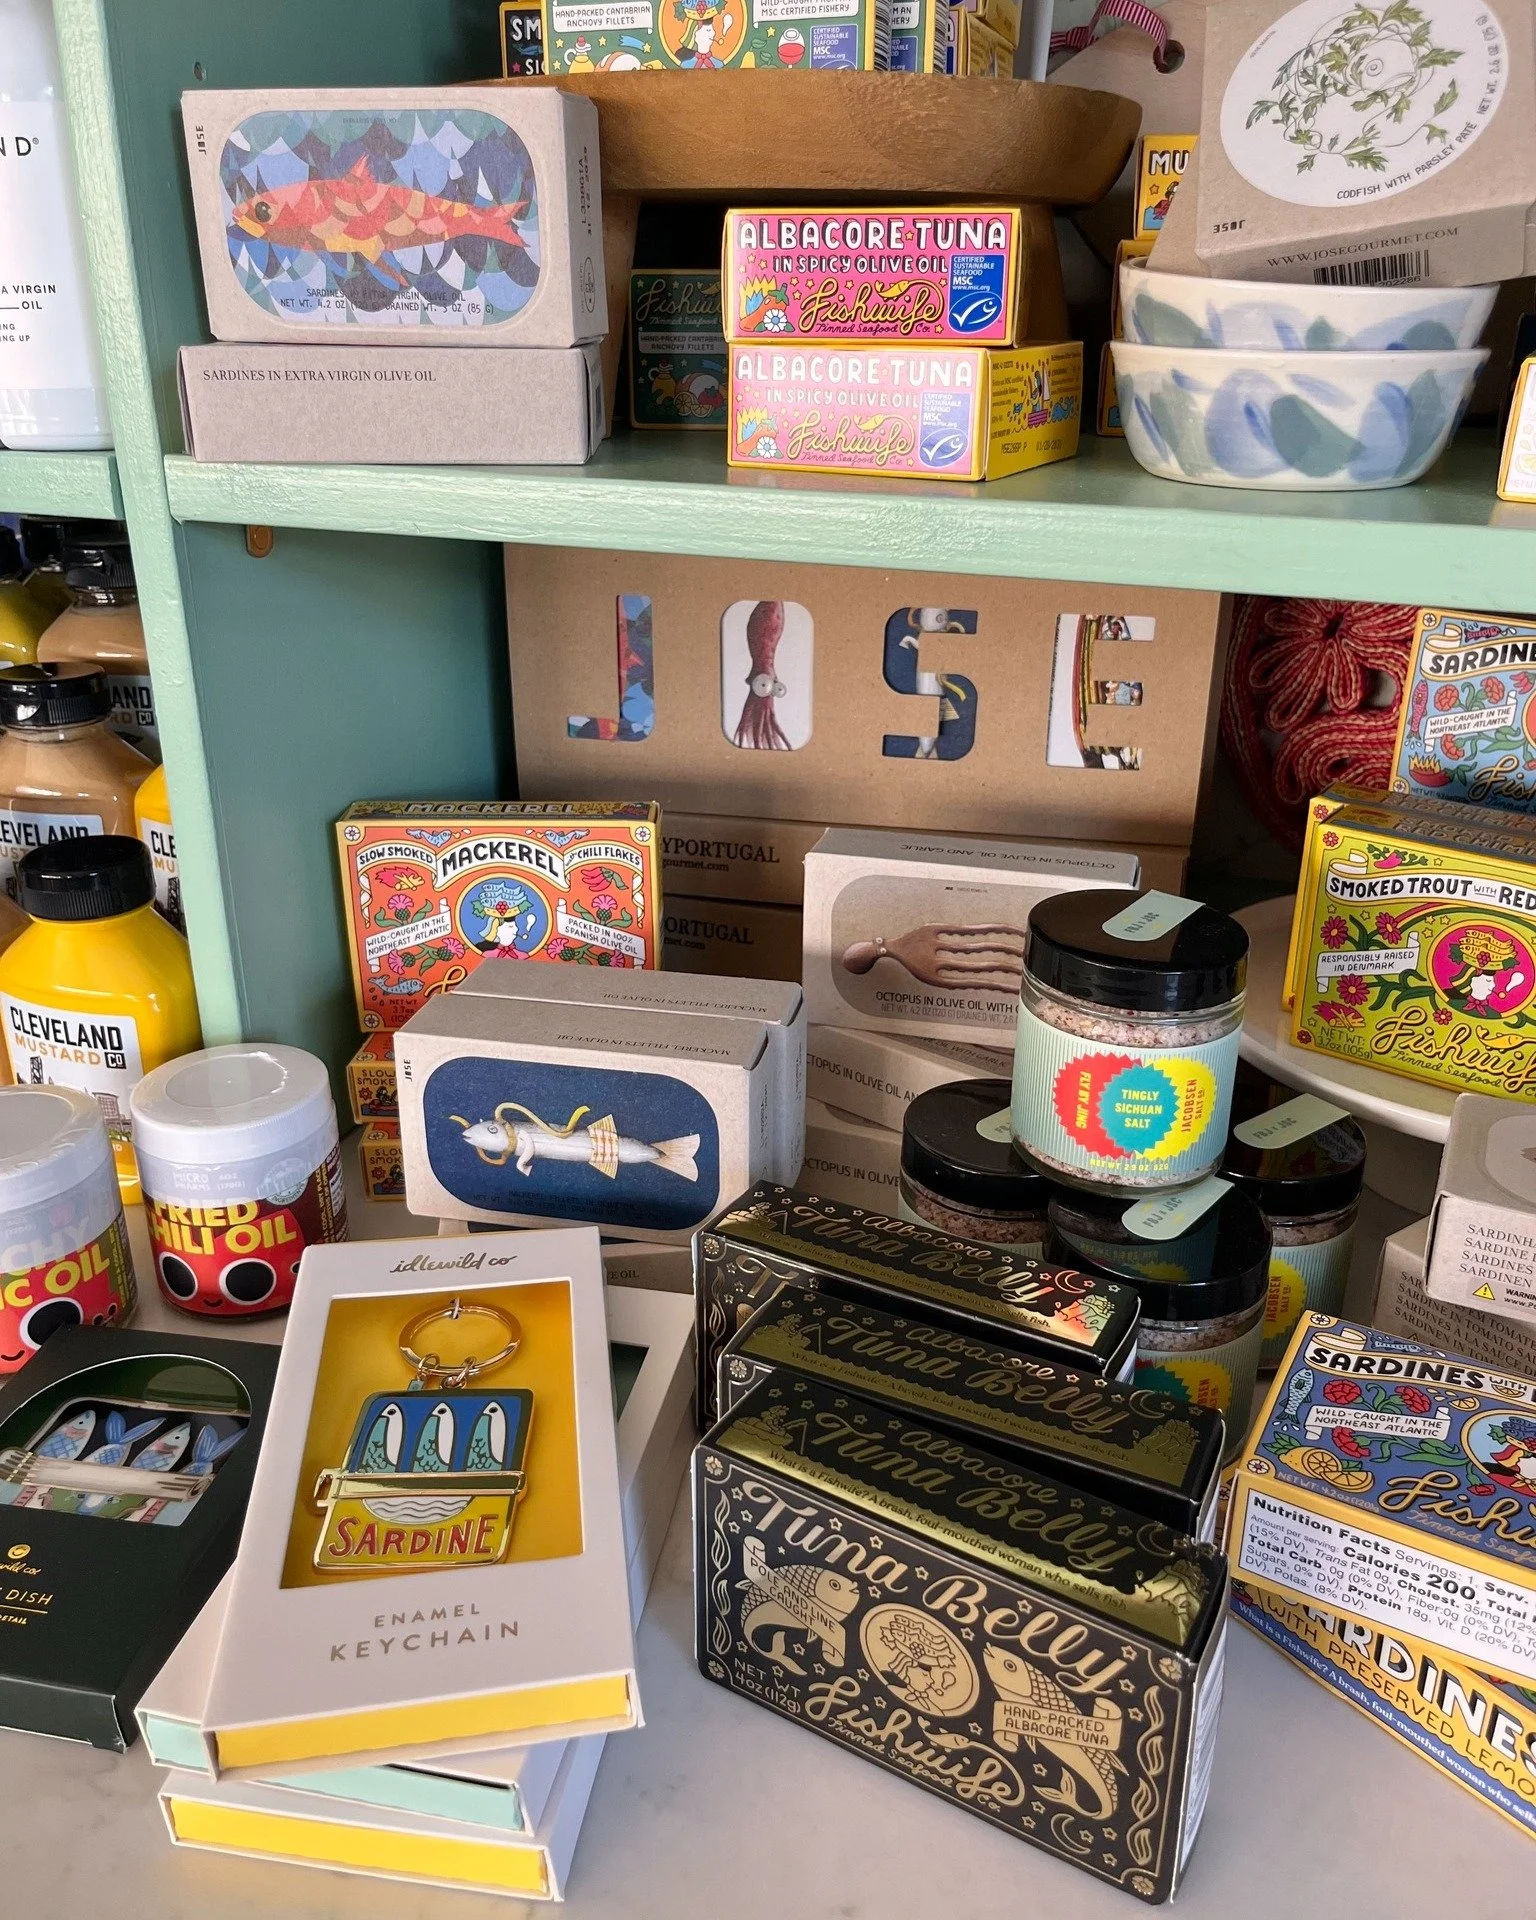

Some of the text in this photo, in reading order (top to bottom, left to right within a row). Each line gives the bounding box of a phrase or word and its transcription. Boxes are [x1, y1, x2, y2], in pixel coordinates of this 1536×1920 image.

[555, 5, 651, 19] HAND-PACKED CANTABRIAN
[566, 16, 635, 27] ANCHOVY FILLETS
[761, 4, 850, 17] MSC CERTIFIED FISHERY
[813, 46, 831, 55] MSC
[1336, 146, 1456, 200] CODFISH WITH PARSLEY
[739, 217, 1006, 250] ALBACORE TUNA
[773, 253, 949, 274] IN SPICY OLIVE OIL
[953, 262, 995, 270] SUSTAINABLE
[13, 285, 57, 294] VIRGIN
[953, 276, 974, 286] MSC
[22, 300, 43, 310] OIL
[799, 277, 945, 334] Fishwife
[856, 323, 898, 337] Seafood
[203, 370, 436, 382] SARDINES IN EXTRA VIRGIN OLIVE OIL
[736, 351, 973, 387] ALBACORE TUNA
[767, 388, 919, 409] IN SPICY OLIVE OIL
[787, 410, 915, 467] Fishwife
[1429, 707, 1512, 726] WILD-CAUGHT IN THE
[1473, 717, 1509, 728] ATLANTIC
[359, 841, 641, 878] SLOW SMOKED MACKEREL CHILI FLAKES
[1056, 858, 1115, 870] OCTOPUS
[1329, 877, 1404, 898] SMOKED
[1407, 877, 1473, 897] TROUT
[1473, 885, 1498, 896] WITH
[367, 916, 446, 948] WILD-CAUGHT IN THE
[368, 923, 451, 956] NORTHEAST ATLANTIC
[565, 925, 638, 955] SPANISH OLIVE OIL
[568, 918, 611, 937] PACKED IN
[1321, 951, 1415, 963] RESPONSIBLY RAISED
[1334, 962, 1395, 972] IN DENMARK
[875, 991, 1013, 1013] OCTOPUS IN OLIVE OIL WITH
[10, 1005, 123, 1051] CLEVELAND
[14, 1034, 101, 1066] MUSTARD
[842, 1066, 902, 1099] IN OLIVE OIL
[1444, 1064, 1502, 1089] Seafood
[1121, 1089, 1160, 1101] TINGLY
[1181, 1079, 1198, 1133] JACOBSEN
[1114, 1103, 1163, 1115] SICHUAN
[1124, 1118, 1151, 1129] SALT
[853, 1168, 900, 1188] IN OLIVE
[153, 1197, 260, 1228] FRIED
[225, 1218, 297, 1255] OIL
[1464, 1237, 1528, 1262] SARDINE
[390, 1252, 518, 1274] idlewild co
[792, 1205, 909, 1258] Tuna
[910, 1249, 1055, 1304] Belly
[1461, 1250, 1533, 1276] SARDINES
[45, 1244, 111, 1295] OIL
[620, 1270, 640, 1279] OIL
[1458, 1262, 1533, 1288] SARDINEN
[1265, 1275, 1284, 1323] JACOBSEN
[826, 1315, 962, 1380] Tuna
[964, 1368, 1130, 1434] Belly
[1309, 1347, 1528, 1392] SARDINES WITH
[1314, 1416, 1440, 1437] NORTHEAST ATLANTIC
[1315, 1407, 1443, 1429] WILD-CAUGHT IN THE
[811, 1412, 1136, 1573] Tuna Belly
[327, 1514, 499, 1557] SARDINE
[817, 1470, 1100, 1598] Fishwife? foul-mouthed woman sells
[1248, 1533, 1285, 1555] Total
[1253, 1496, 1530, 1605] Nutrition Facts Servings: Serv.
[1250, 1514, 1528, 1620] Amount serving: Calories 200, Total
[1273, 1566, 1310, 1589] Potas.
[1315, 1548, 1460, 1608] Trans Cholest.
[5, 1589, 54, 1606] DISH
[742, 1480, 1129, 1696] Tuna Belly
[750, 1557, 837, 1634] POLE AND LINE
[1347, 1583, 1402, 1611] Protein
[374, 1603, 481, 1629] ENAMEL
[769, 1586, 815, 1627] CAUGHT
[330, 1620, 519, 1663] KEYCHAIN
[734, 1657, 766, 1680] NET
[1267, 1595, 1455, 1739] WITH PRESERVED
[1003, 1704, 1105, 1733] HAND-PACKED
[1282, 1634, 1486, 1789] Fishwife? brash, foul-mouthed woman
[804, 1674, 1025, 1807] Fishwife
[1004, 1717, 1110, 1746] ALBACORE TUNA
